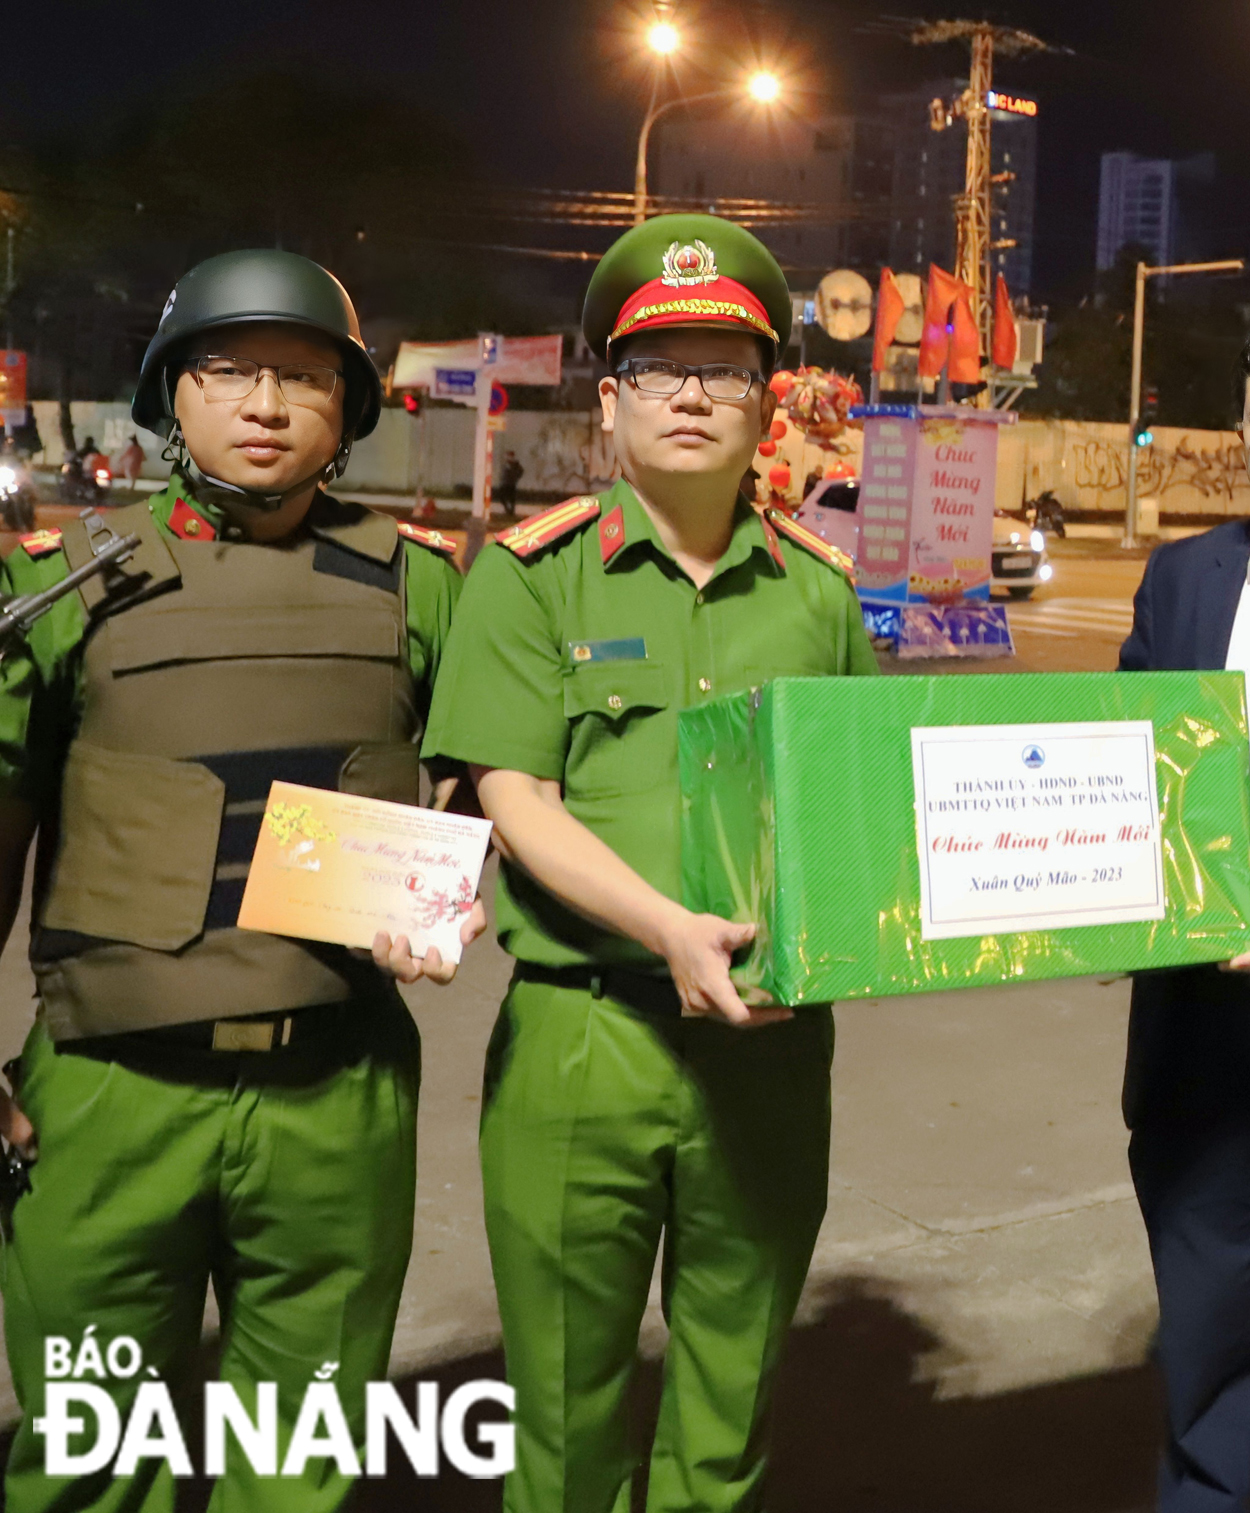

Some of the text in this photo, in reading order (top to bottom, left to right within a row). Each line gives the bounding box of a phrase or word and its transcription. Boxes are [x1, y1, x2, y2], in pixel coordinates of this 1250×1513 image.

[1007, 96, 1037, 117] LAND
[1088, 774, 1123, 788] UBND
[928, 799, 991, 813] UBMTTQ
[1032, 794, 1062, 807] NAM
[932, 835, 983, 853] Chúc
[969, 875, 1008, 892] Xuân
[1047, 870, 1077, 887] Mão
[1092, 866, 1123, 884] 2023
